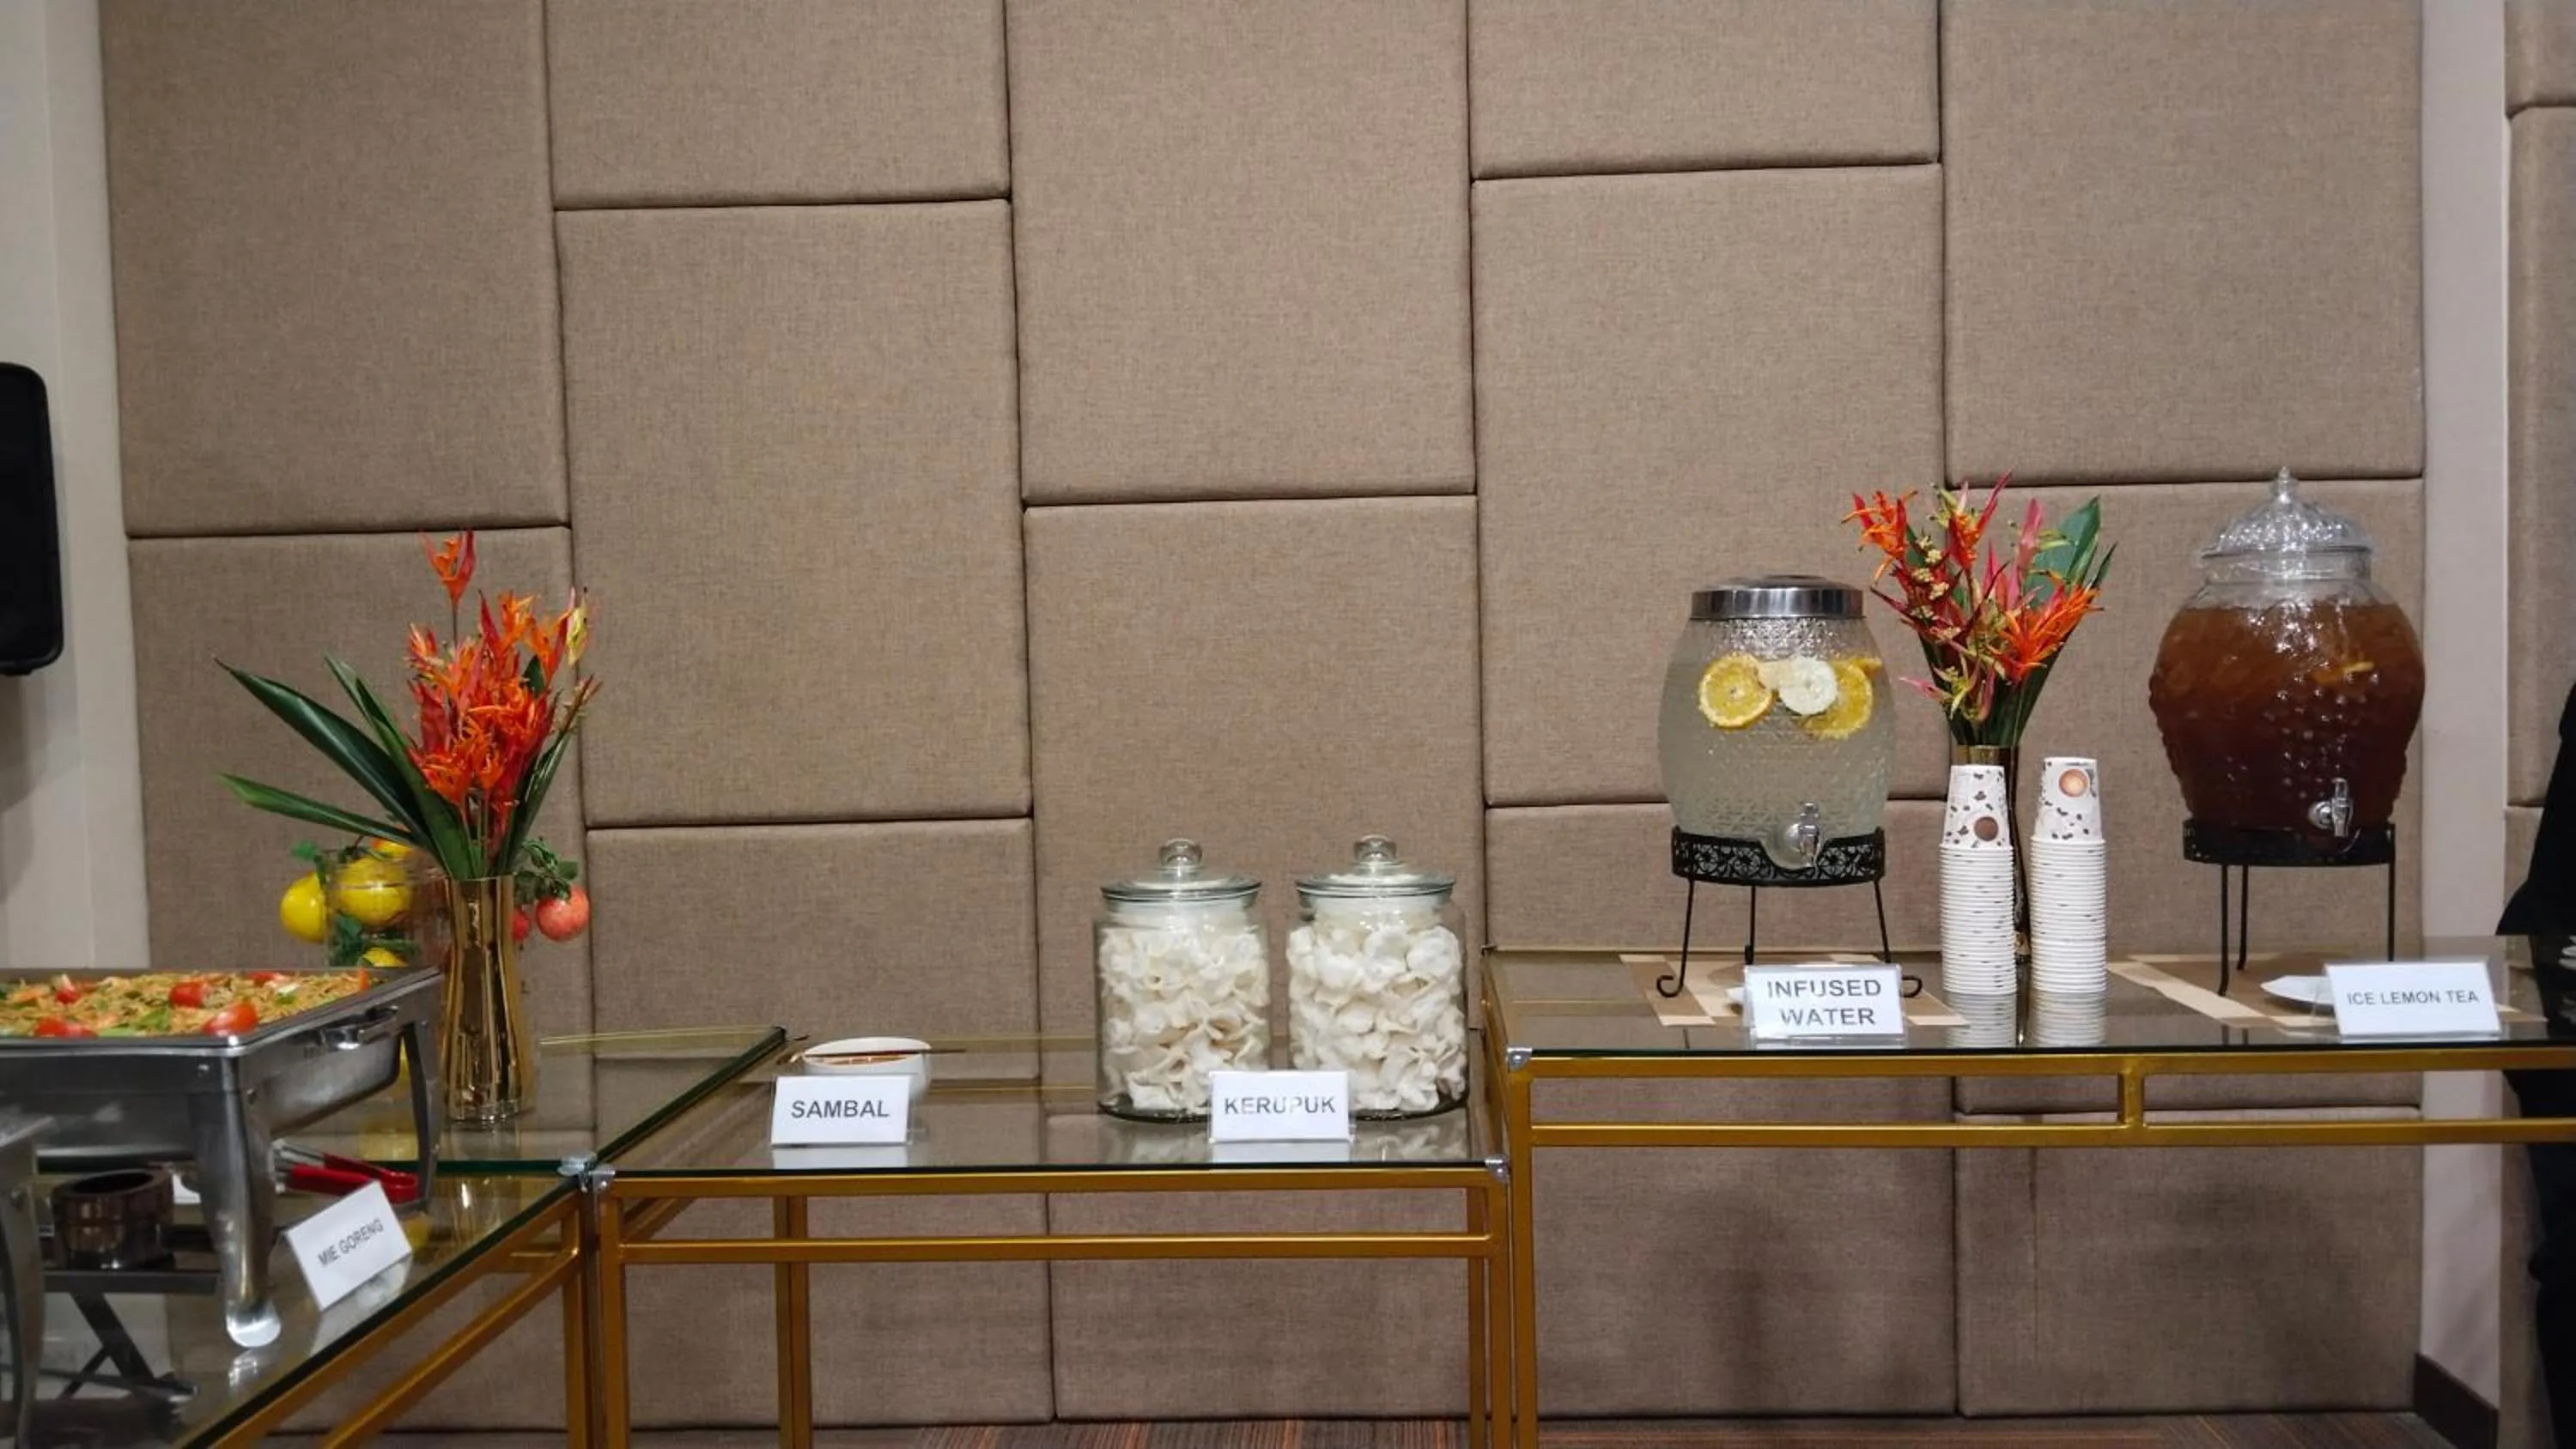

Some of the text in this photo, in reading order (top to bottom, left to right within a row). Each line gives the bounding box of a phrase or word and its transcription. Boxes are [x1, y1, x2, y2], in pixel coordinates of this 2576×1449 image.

[1767, 979, 1881, 997] INFUSED
[2347, 990, 2480, 1005] ICE LEMON TEA
[1779, 1008, 1876, 1026] WATER
[791, 1100, 890, 1119] SAMBAL
[1224, 1096, 1336, 1115] KERUPUK
[317, 1218, 385, 1267] MIE GORENG
